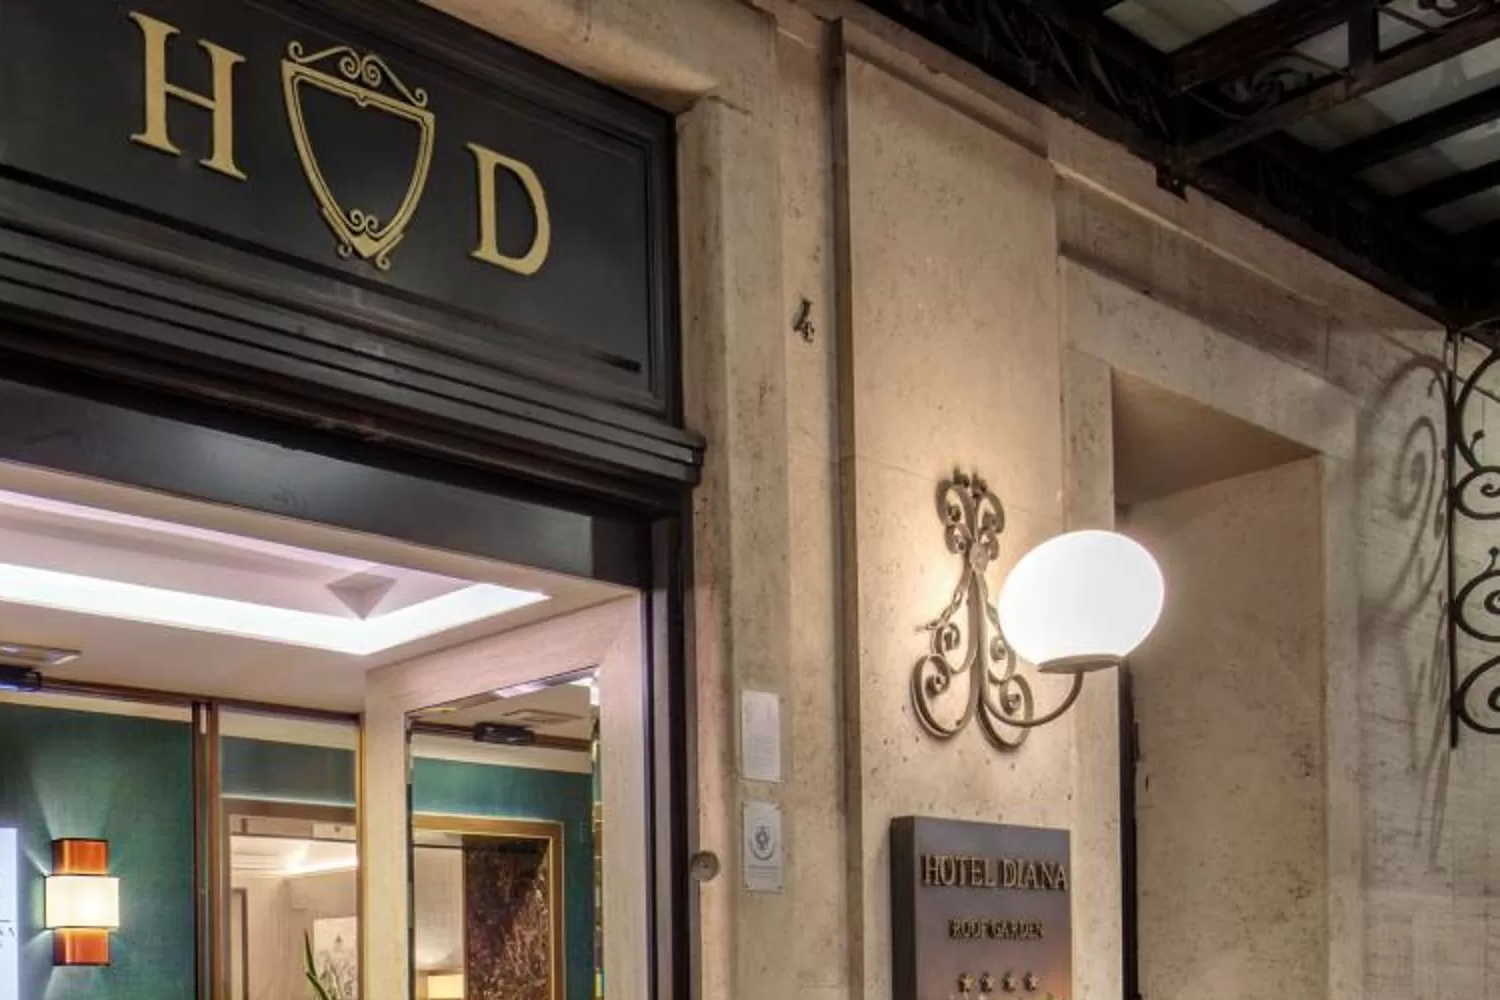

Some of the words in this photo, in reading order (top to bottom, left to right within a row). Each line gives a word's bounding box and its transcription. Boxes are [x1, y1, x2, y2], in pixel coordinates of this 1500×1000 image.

[129, 11, 248, 181] H
[466, 142, 552, 276] D
[921, 853, 996, 888] HOTEL
[1002, 858, 1068, 891] DIANA
